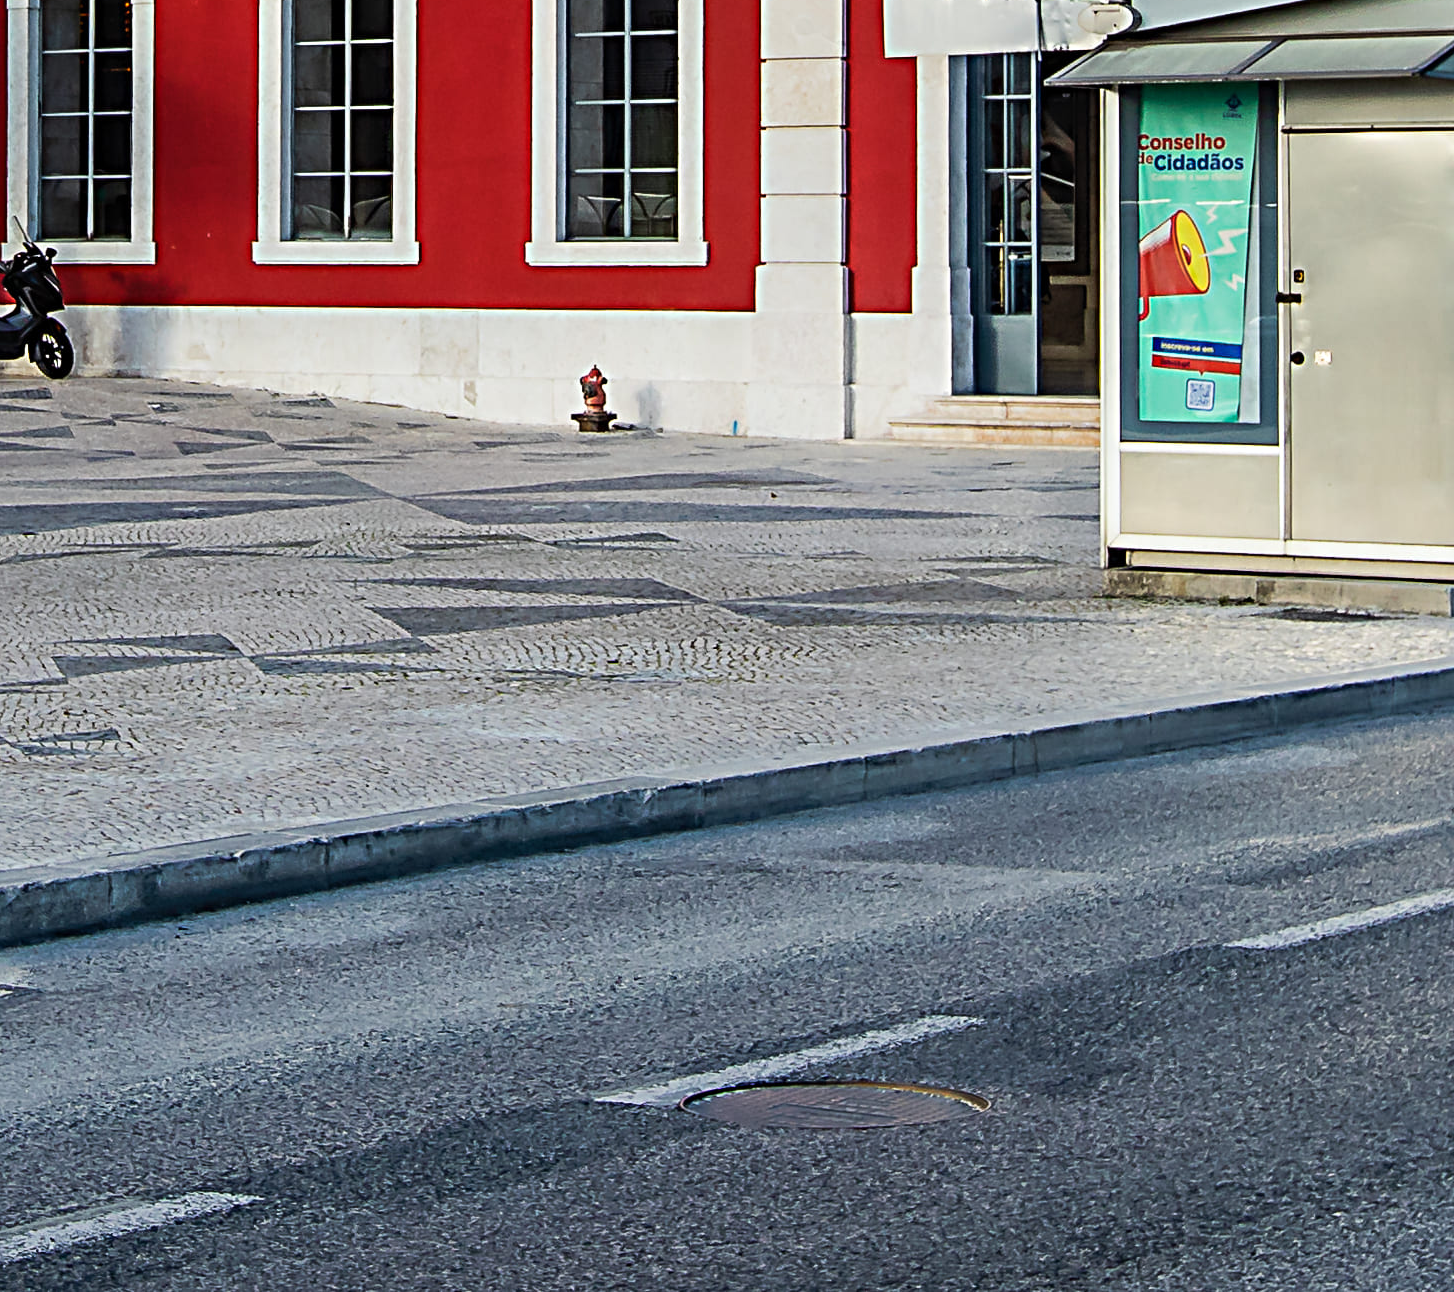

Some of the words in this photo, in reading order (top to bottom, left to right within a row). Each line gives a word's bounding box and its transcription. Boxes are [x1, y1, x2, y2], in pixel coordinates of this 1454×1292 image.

[1137, 133, 1226, 150] Conselho
[1138, 152, 1153, 165] de
[1154, 153, 1244, 171] Cidadãos
